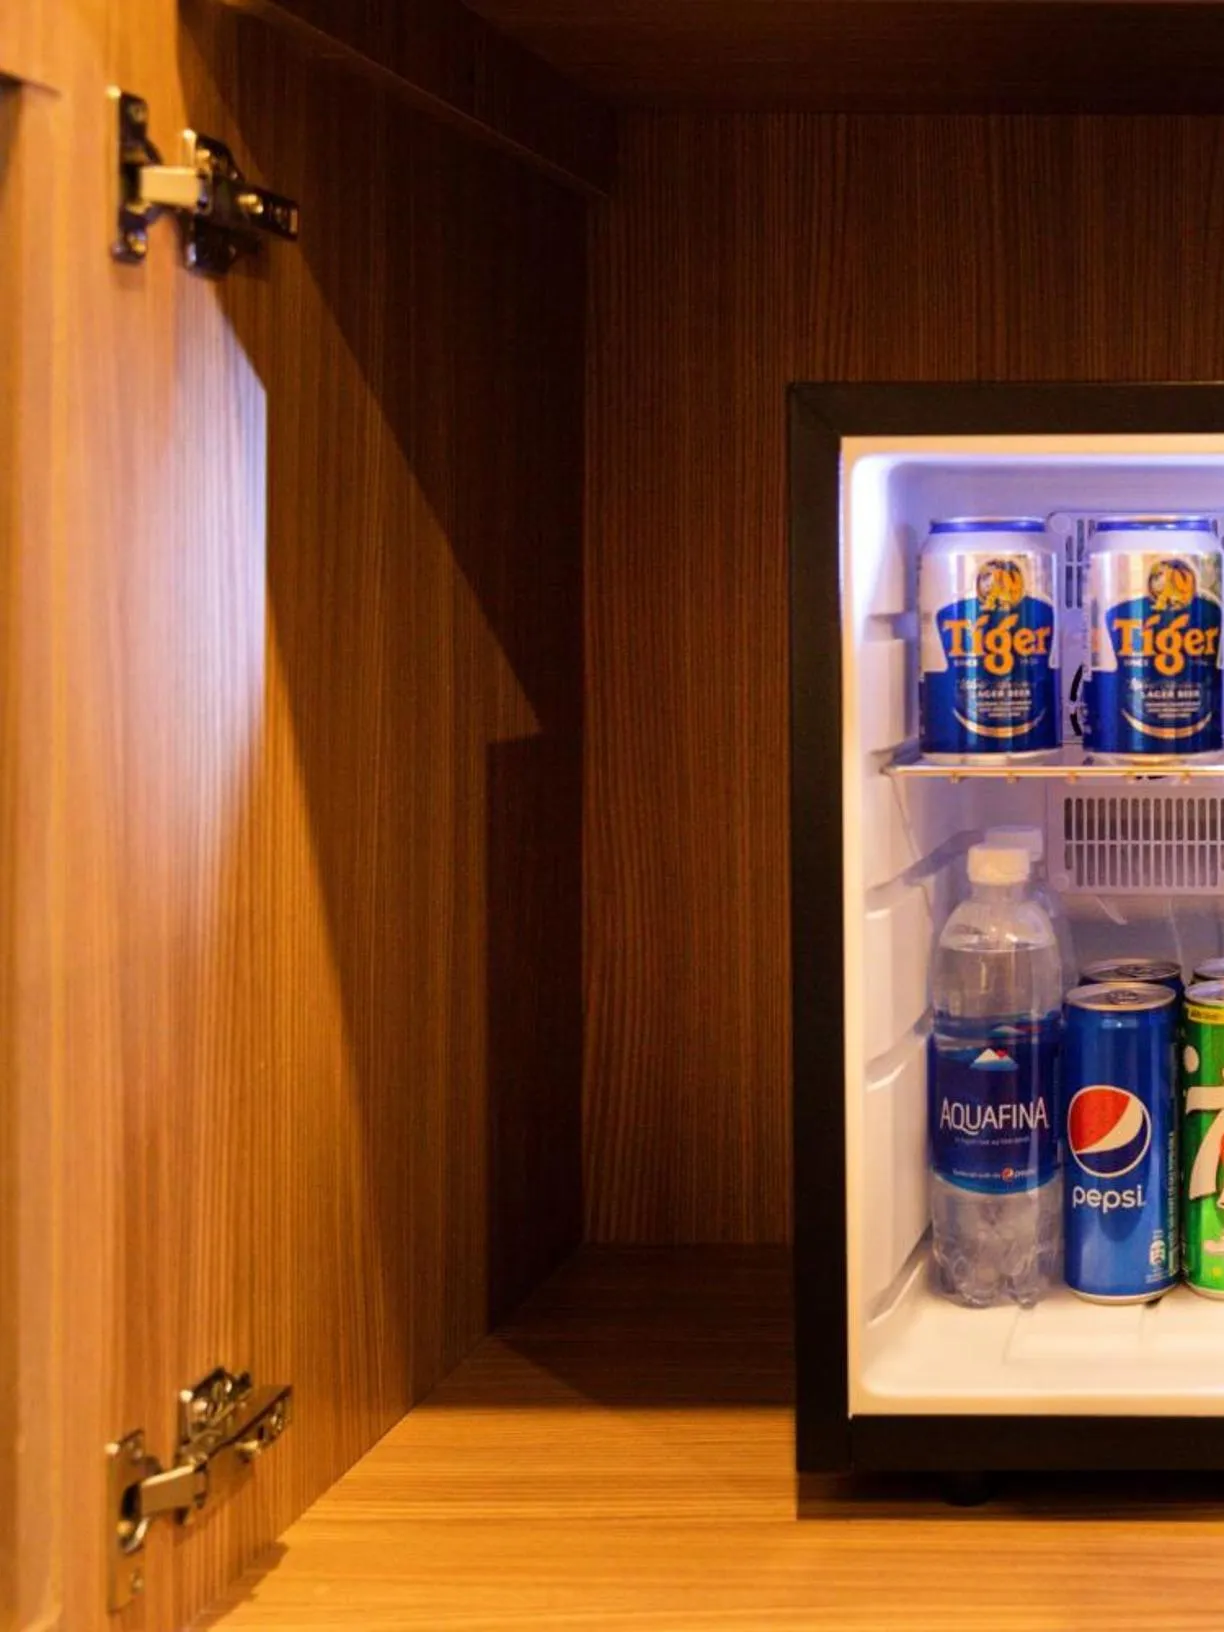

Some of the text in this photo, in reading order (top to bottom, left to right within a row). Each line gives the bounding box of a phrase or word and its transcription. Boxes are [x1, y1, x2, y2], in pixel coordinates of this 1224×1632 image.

[944, 614, 1050, 676] Tiger
[1113, 614, 1219, 677] Tiger
[940, 1096, 1047, 1135] AQUAFINA
[1072, 1184, 1142, 1214] pepsi
